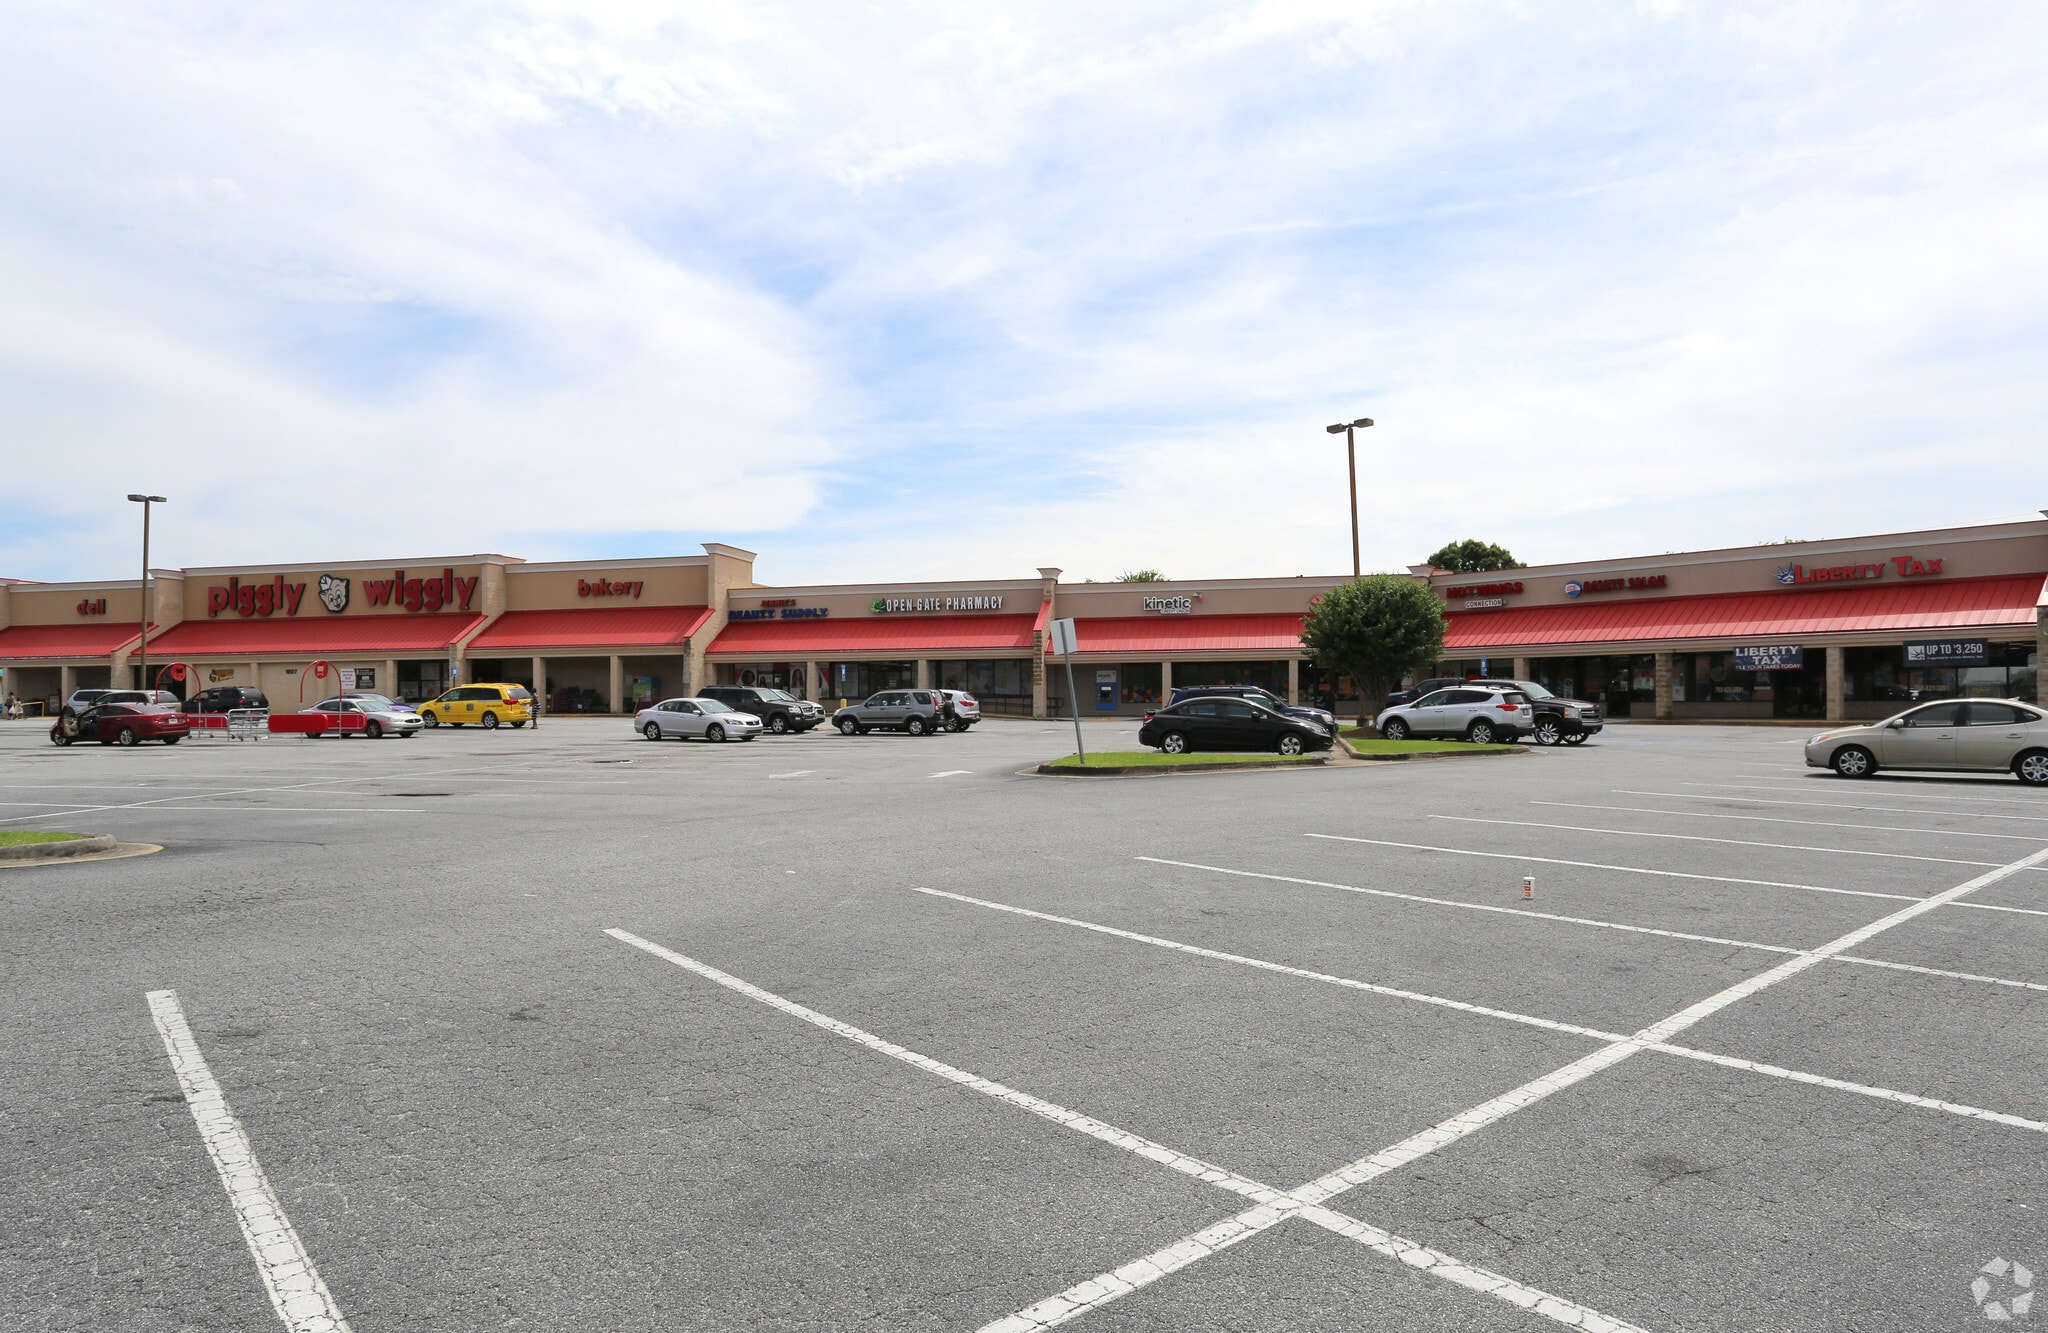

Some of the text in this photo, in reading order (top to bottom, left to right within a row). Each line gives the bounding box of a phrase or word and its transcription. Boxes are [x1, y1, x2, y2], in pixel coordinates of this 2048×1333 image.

[1794, 556, 1944, 584] LIBERTY TAX
[208, 568, 478, 617] piggly wiggly
[577, 578, 643, 599] bakery
[1446, 586, 1475, 599] HOT
[76, 599, 106, 615] deli
[886, 596, 1003, 612] OPEN GATE PHARMACY
[1144, 596, 1191, 609] kinetic
[1466, 600, 1502, 608] CONNECTION
[728, 608, 828, 619] BEAUTY SUPPLY
[1735, 646, 1800, 657] LIBERTY
[1926, 645, 1939, 655] UP
[1940, 644, 1952, 654] TO
[1752, 656, 1782, 665] TAX
